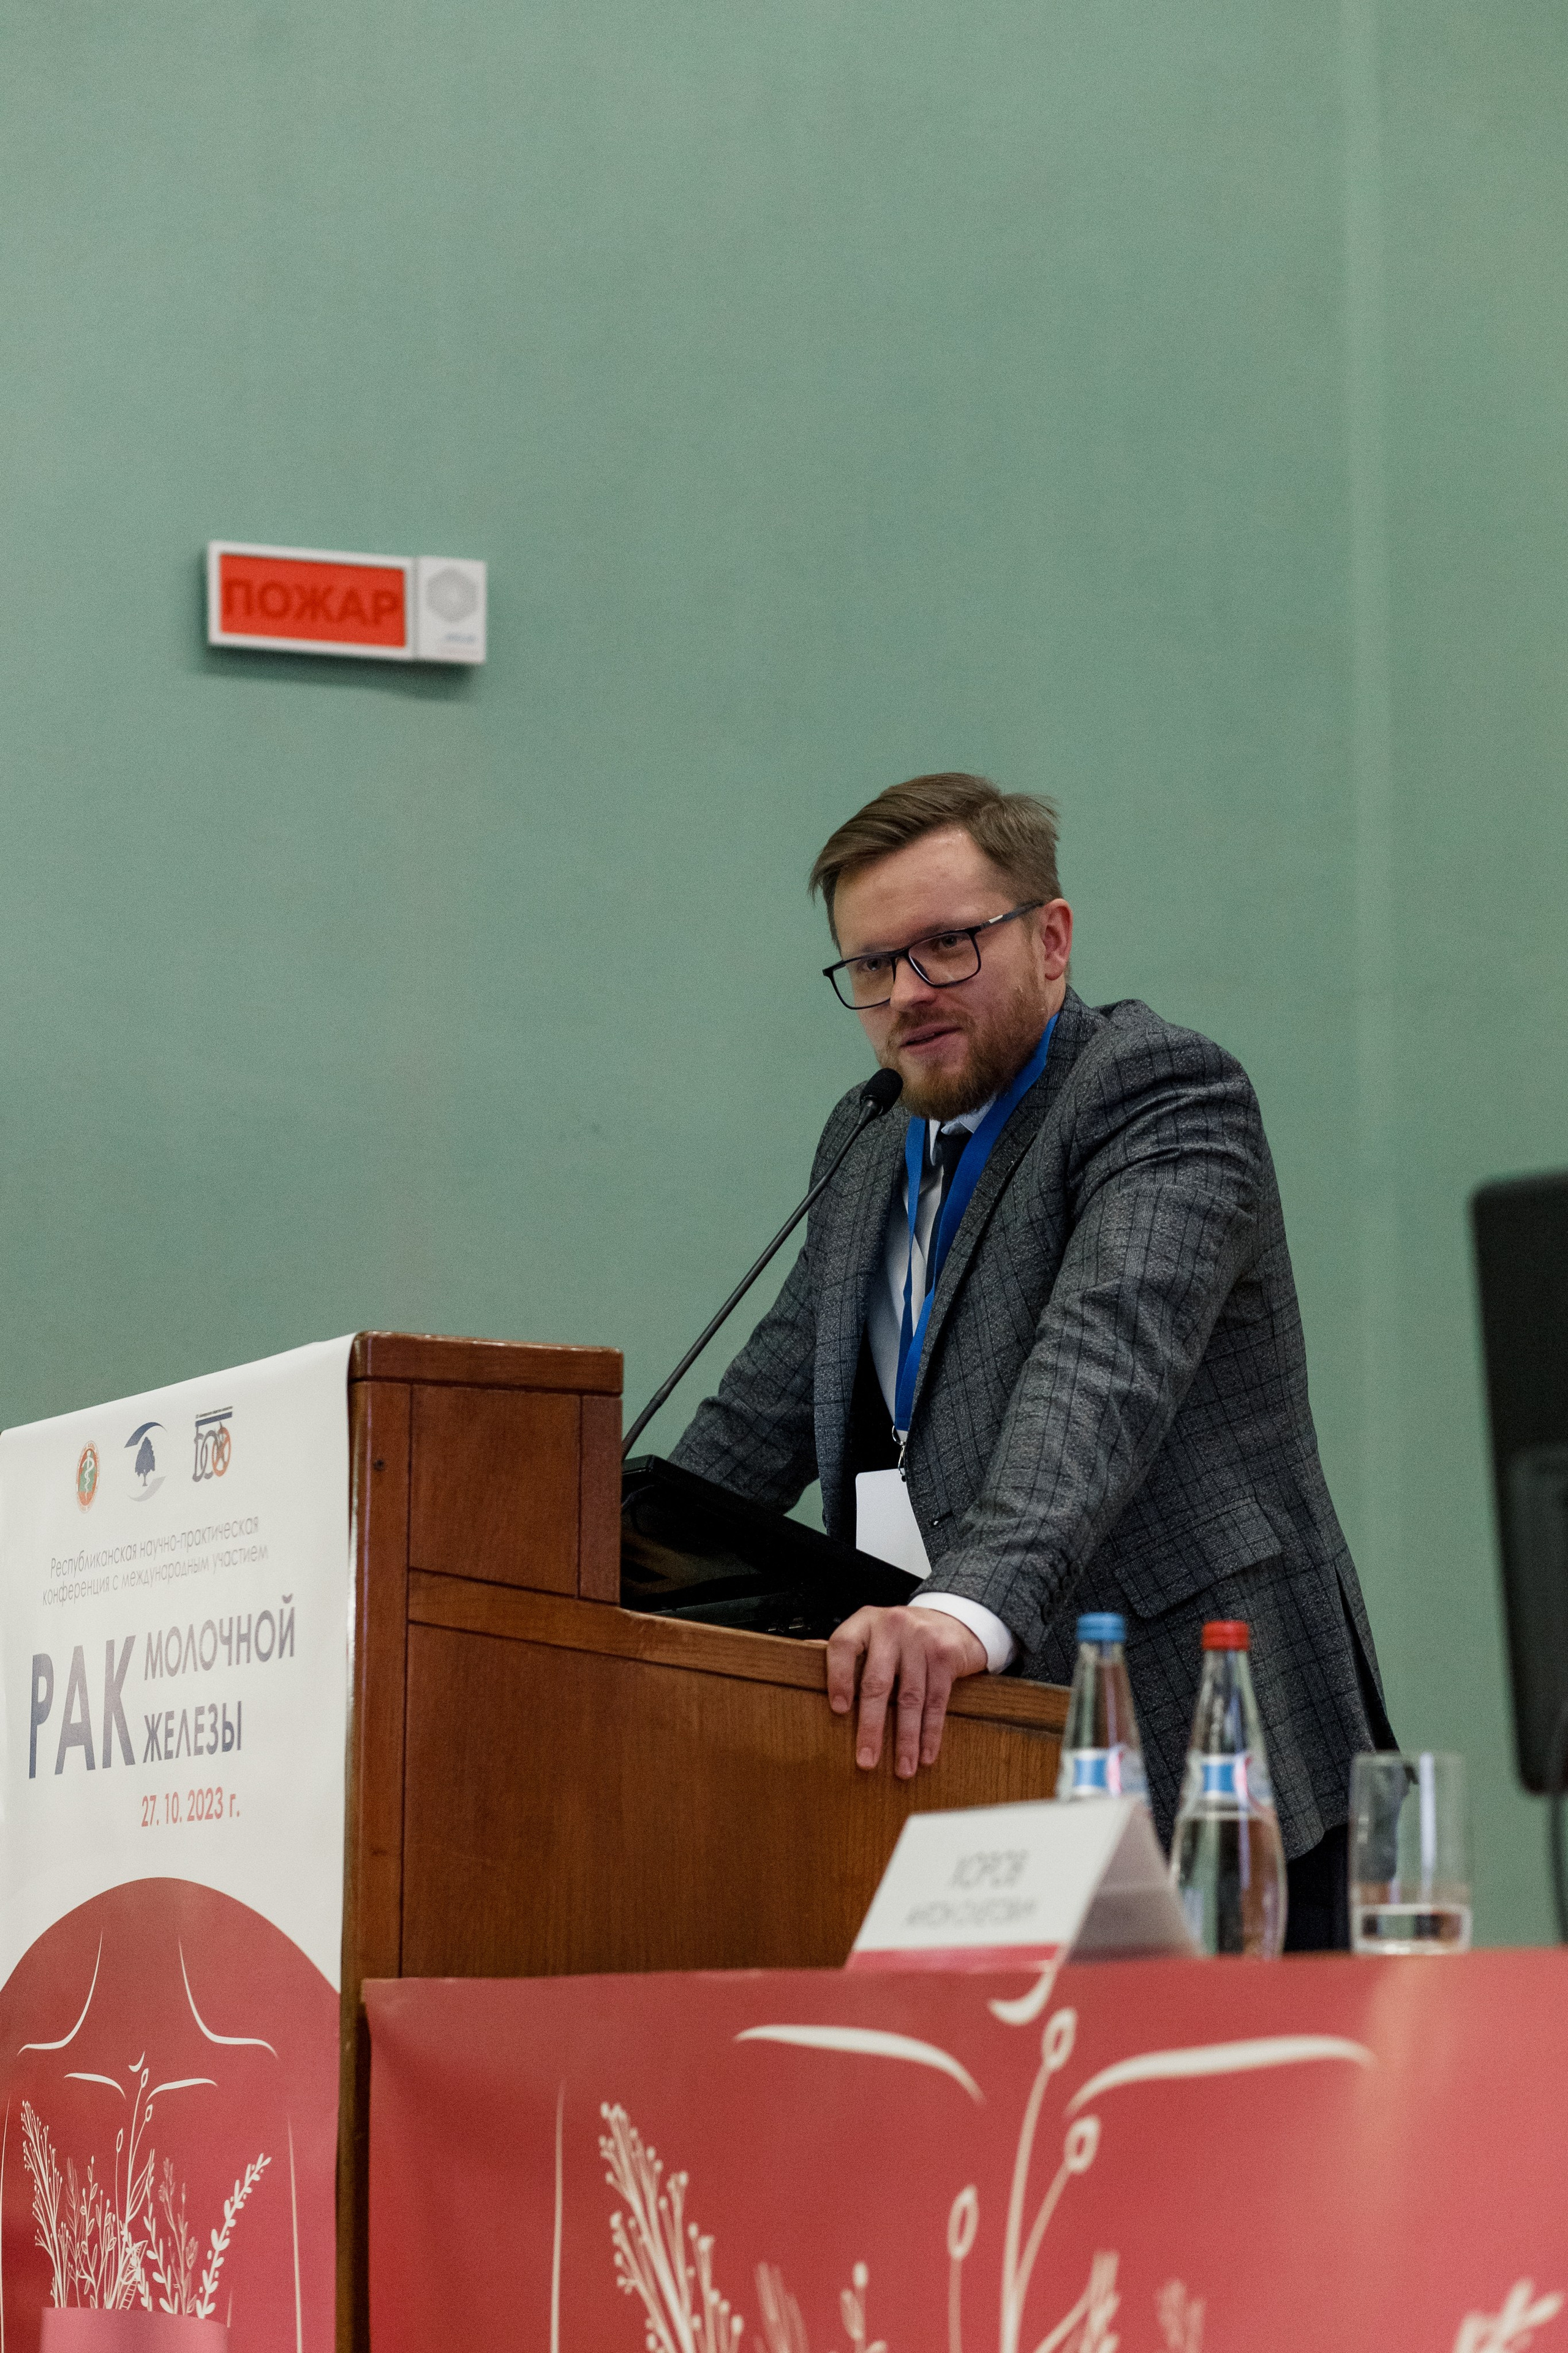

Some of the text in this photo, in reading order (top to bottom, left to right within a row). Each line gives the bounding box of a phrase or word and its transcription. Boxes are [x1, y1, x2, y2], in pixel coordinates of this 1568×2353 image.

[222, 578, 401, 628] ПОЖАР
[42, 1544, 269, 1607] конференция с международным участием
[50, 1516, 259, 1579] Республиканская научно-практическая
[144, 1593, 295, 1680] МОЛОЧНОЙ
[29, 1635, 136, 1779] РАК
[143, 1701, 243, 1763] ЖЕЛЕЗЫ
